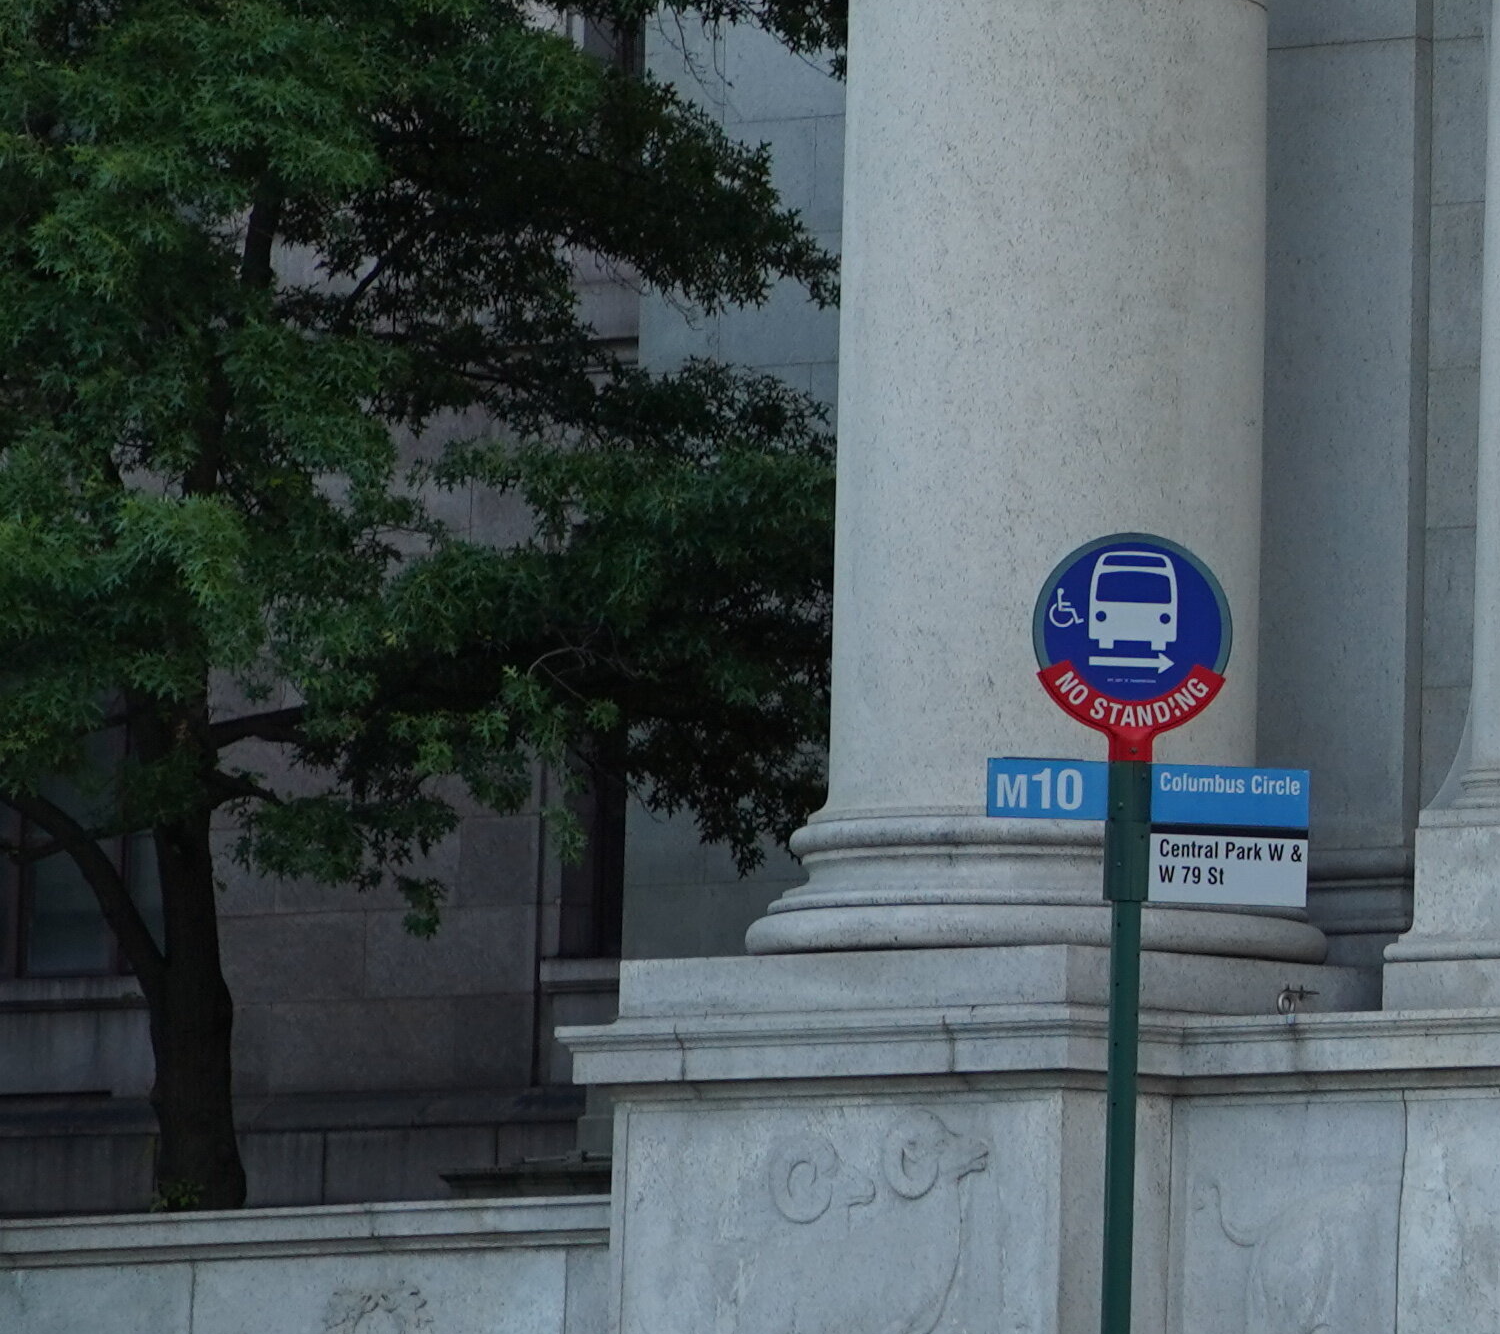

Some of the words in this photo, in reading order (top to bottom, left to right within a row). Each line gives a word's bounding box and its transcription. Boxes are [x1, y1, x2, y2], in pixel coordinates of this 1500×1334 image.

[1055, 671, 1089, 705] NO
[1090, 678, 1209, 727] STANDING
[996, 768, 1083, 810] M10
[1160, 772, 1245, 794] Columbus
[1251, 775, 1300, 795] Circle
[1160, 838, 1218, 859] Central
[1225, 841, 1261, 861] Park
[1269, 844, 1285, 861] W
[1291, 845, 1302, 862] &
[1159, 866, 1175, 883] W
[1182, 867, 1201, 884] 79
[1208, 867, 1224, 885] St
